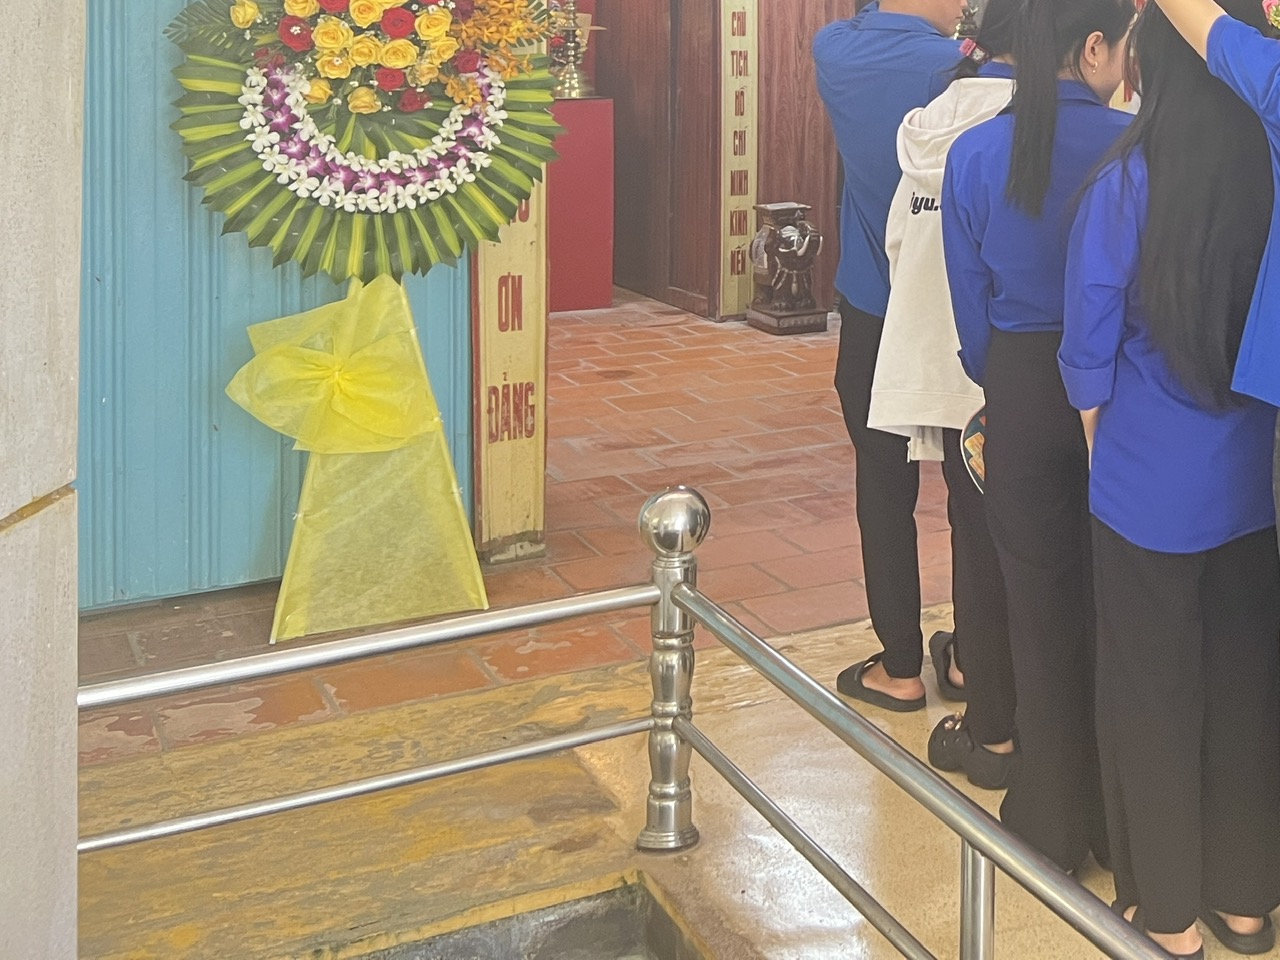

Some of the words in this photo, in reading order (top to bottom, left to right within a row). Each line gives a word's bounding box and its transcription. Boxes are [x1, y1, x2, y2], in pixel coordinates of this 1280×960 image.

[730, 50, 749, 79] TỊCH
[734, 85, 748, 116] HỒ
[733, 125, 748, 156] CHÍ
[730, 169, 749, 197] MINH
[497, 271, 523, 333] ƠN
[487, 372, 535, 444] ĐẢNG
